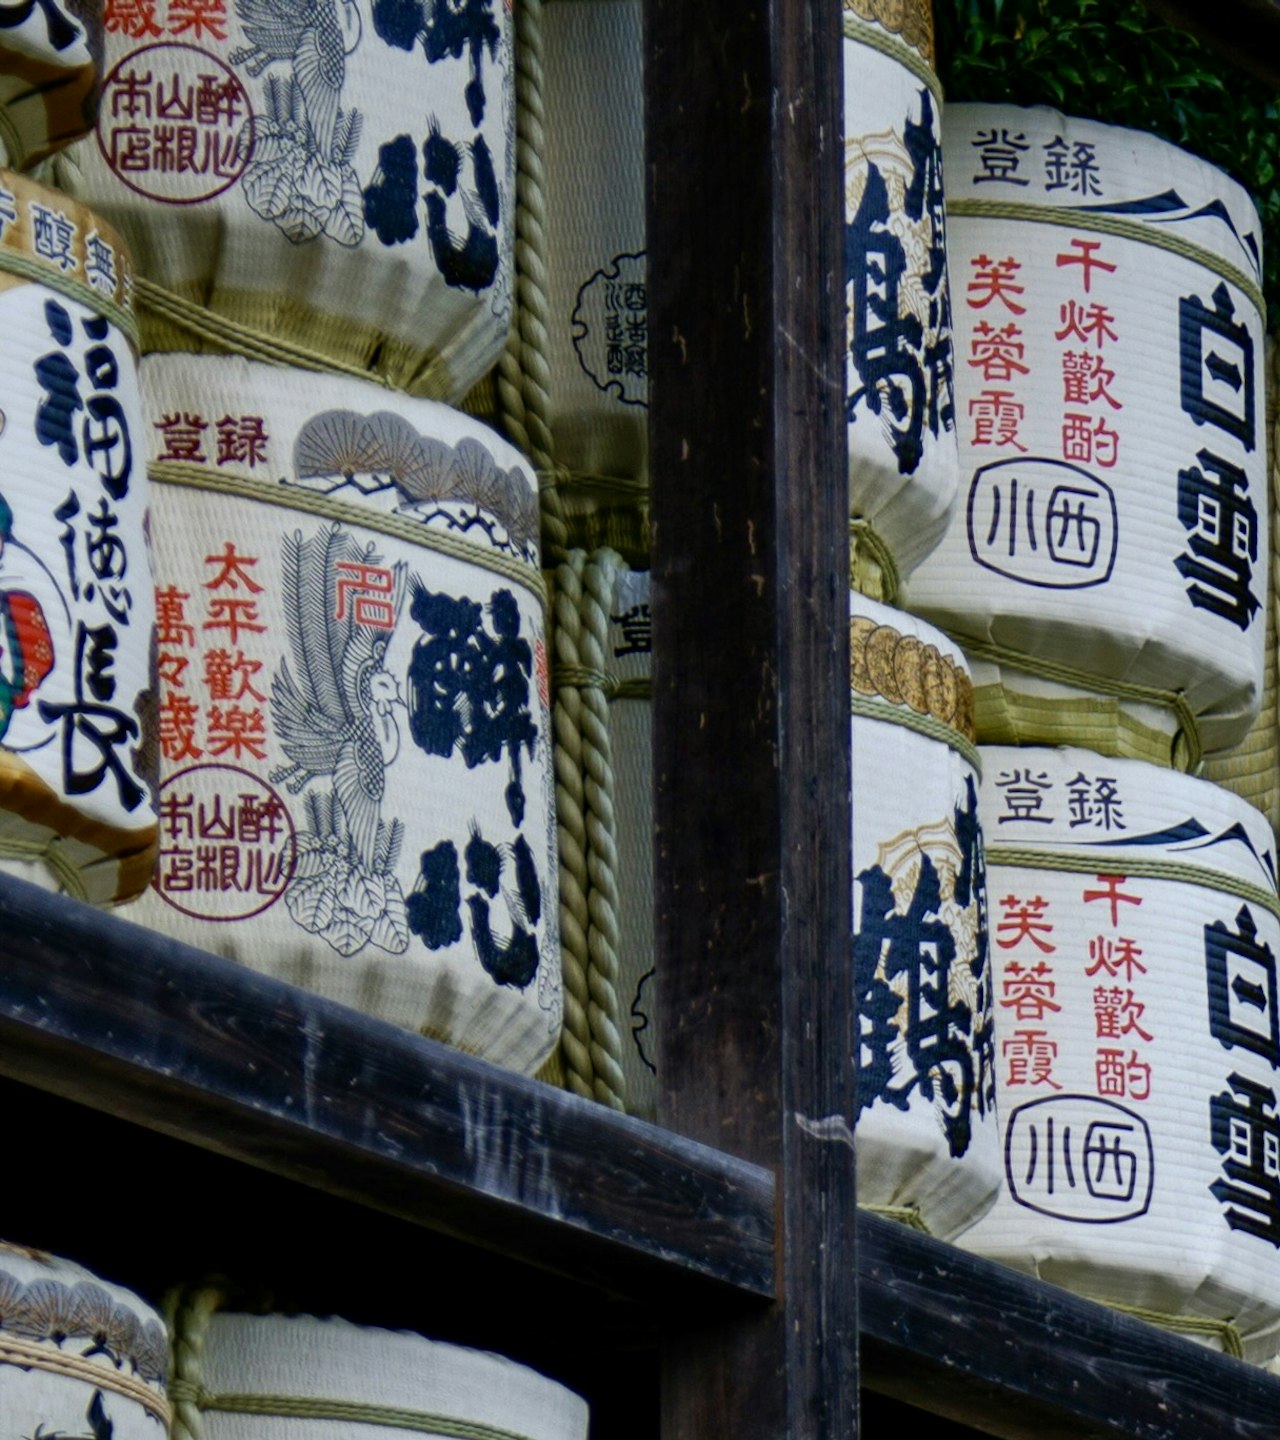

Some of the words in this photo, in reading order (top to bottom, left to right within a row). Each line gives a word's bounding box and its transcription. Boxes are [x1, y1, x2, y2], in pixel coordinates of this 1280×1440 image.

[154, 411, 270, 468] 登録
[966, 253, 1028, 454] 芙蓉霞
[1172, 283, 1262, 632] 白雪
[996, 894, 1062, 1090] 芙蓉霞
